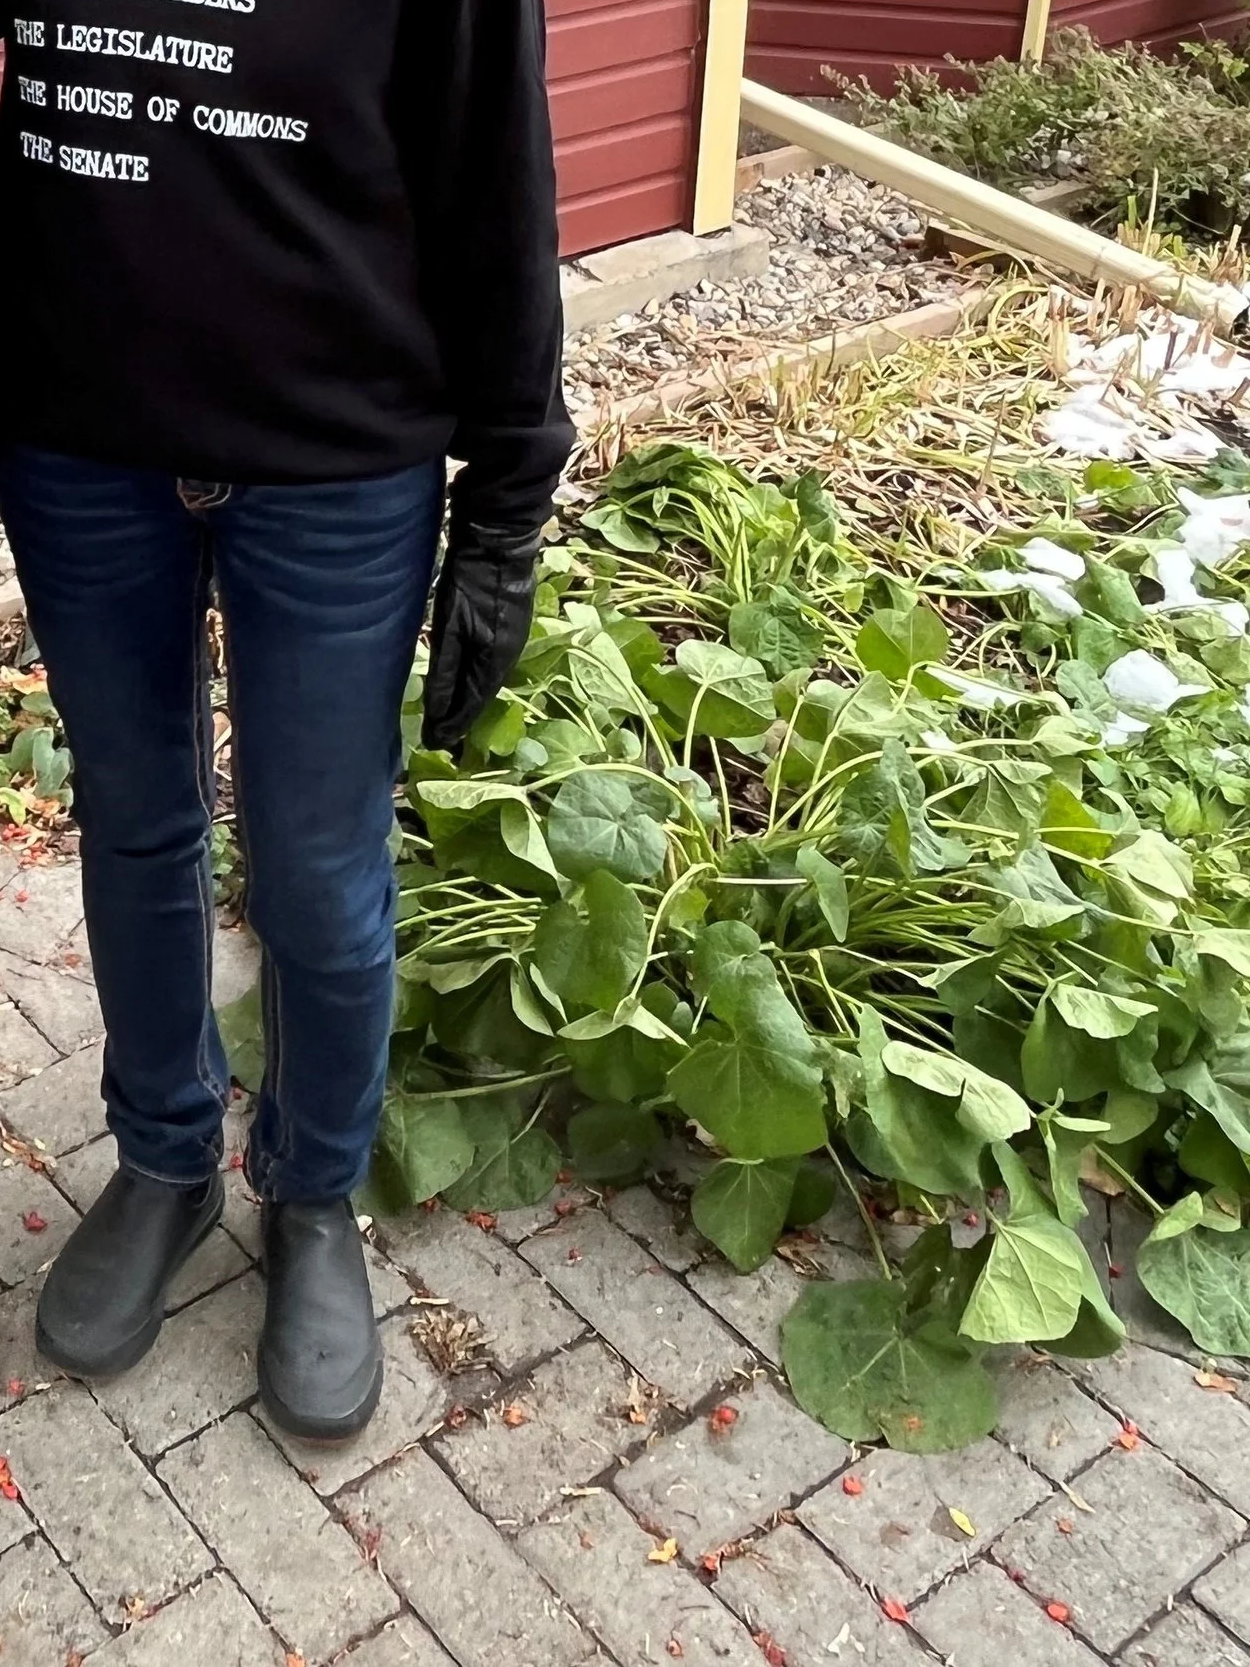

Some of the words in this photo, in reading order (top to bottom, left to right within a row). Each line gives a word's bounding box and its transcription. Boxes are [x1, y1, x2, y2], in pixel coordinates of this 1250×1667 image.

[14, 18, 45, 48] THE
[56, 23, 234, 74] LEGISLATURE
[17, 75, 47, 107] THE
[56, 84, 134, 120] HOUSE
[146, 95, 181, 123] OF
[192, 104, 309, 143] COMMONS
[19, 131, 54, 164] THE
[58, 144, 150, 182] SENATE
